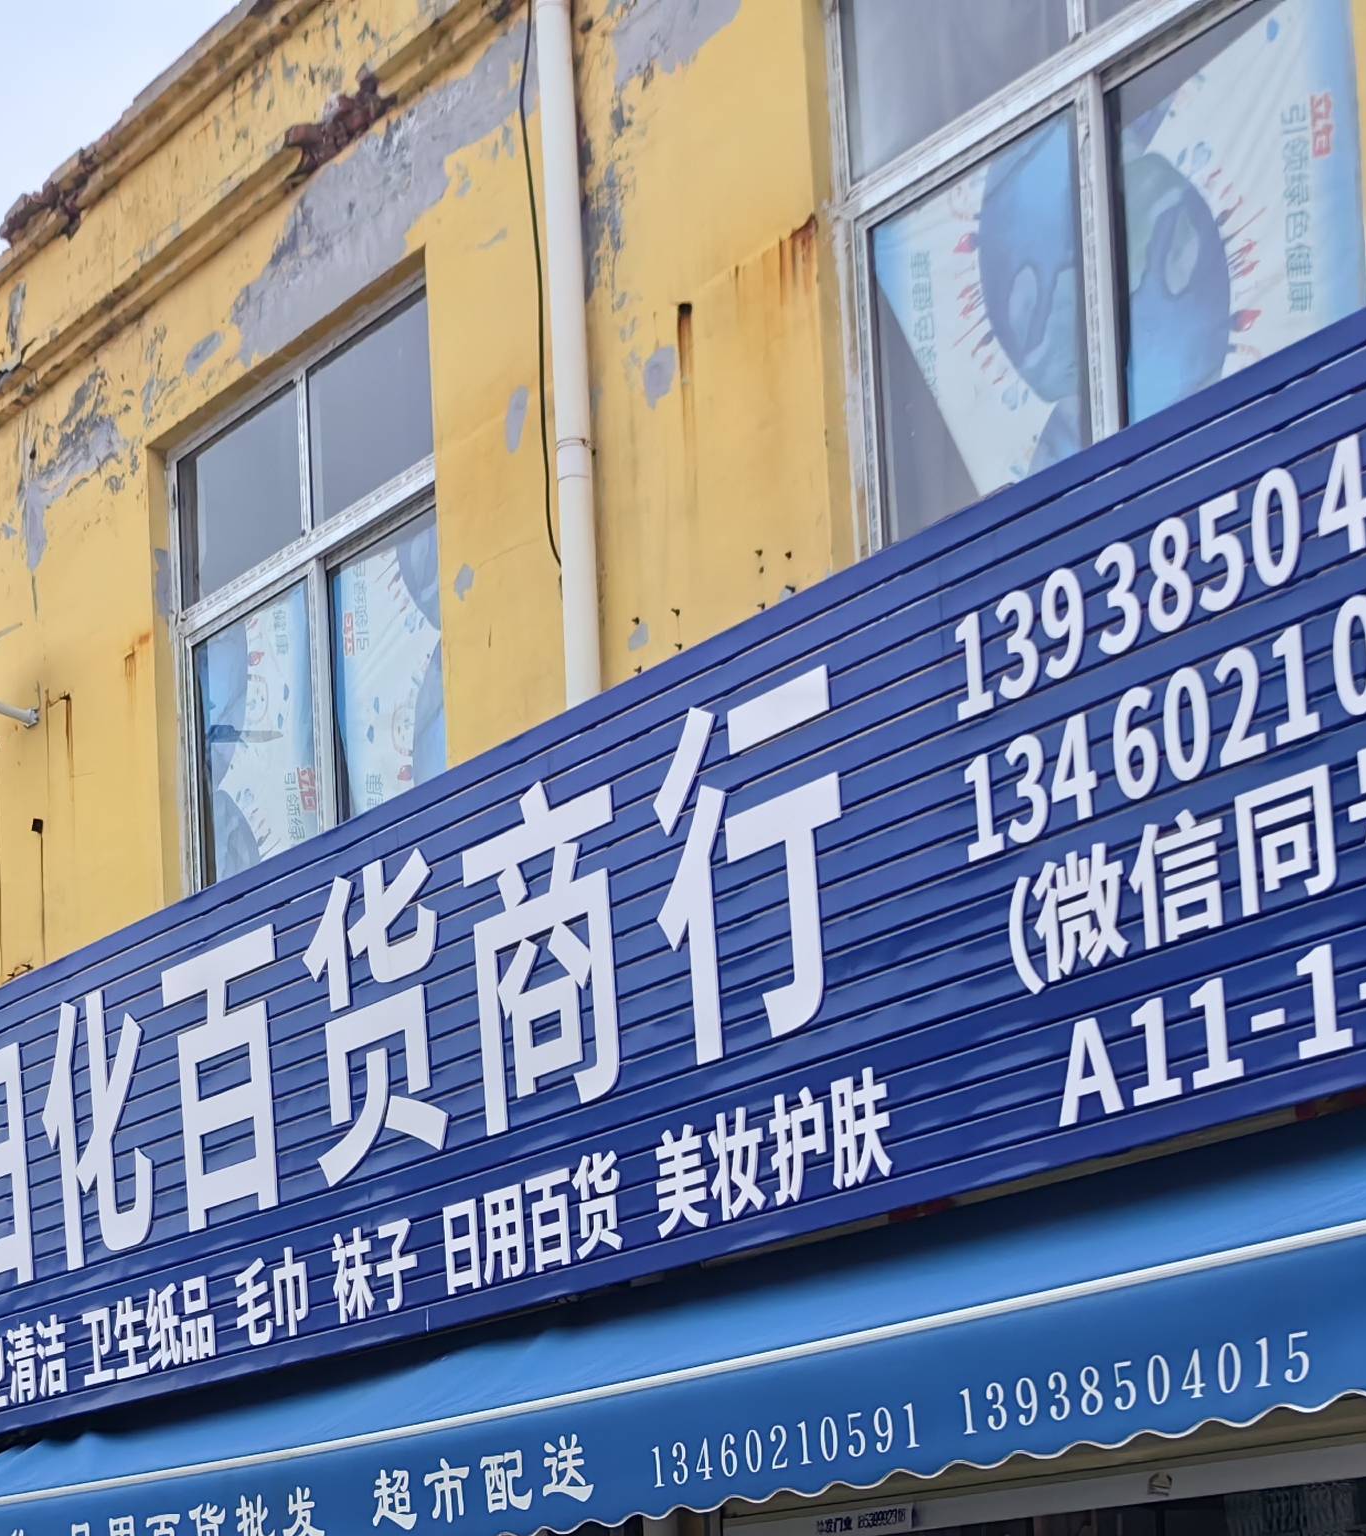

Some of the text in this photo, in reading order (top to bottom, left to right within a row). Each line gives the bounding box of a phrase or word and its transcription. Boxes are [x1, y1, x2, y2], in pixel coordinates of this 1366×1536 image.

[81, 1274, 216, 1390] 卫生纸品
[234, 1260, 308, 1347] 毛巾
[332, 1217, 418, 1324] 袜子
[444, 1153, 623, 1293] 日用百货
[655, 1067, 894, 1240] 美妆护肤
[372, 1432, 595, 1530] 超市配送
[649, 1403, 921, 1489] 13460210591
[960, 1330, 1313, 1436] 13938504015
